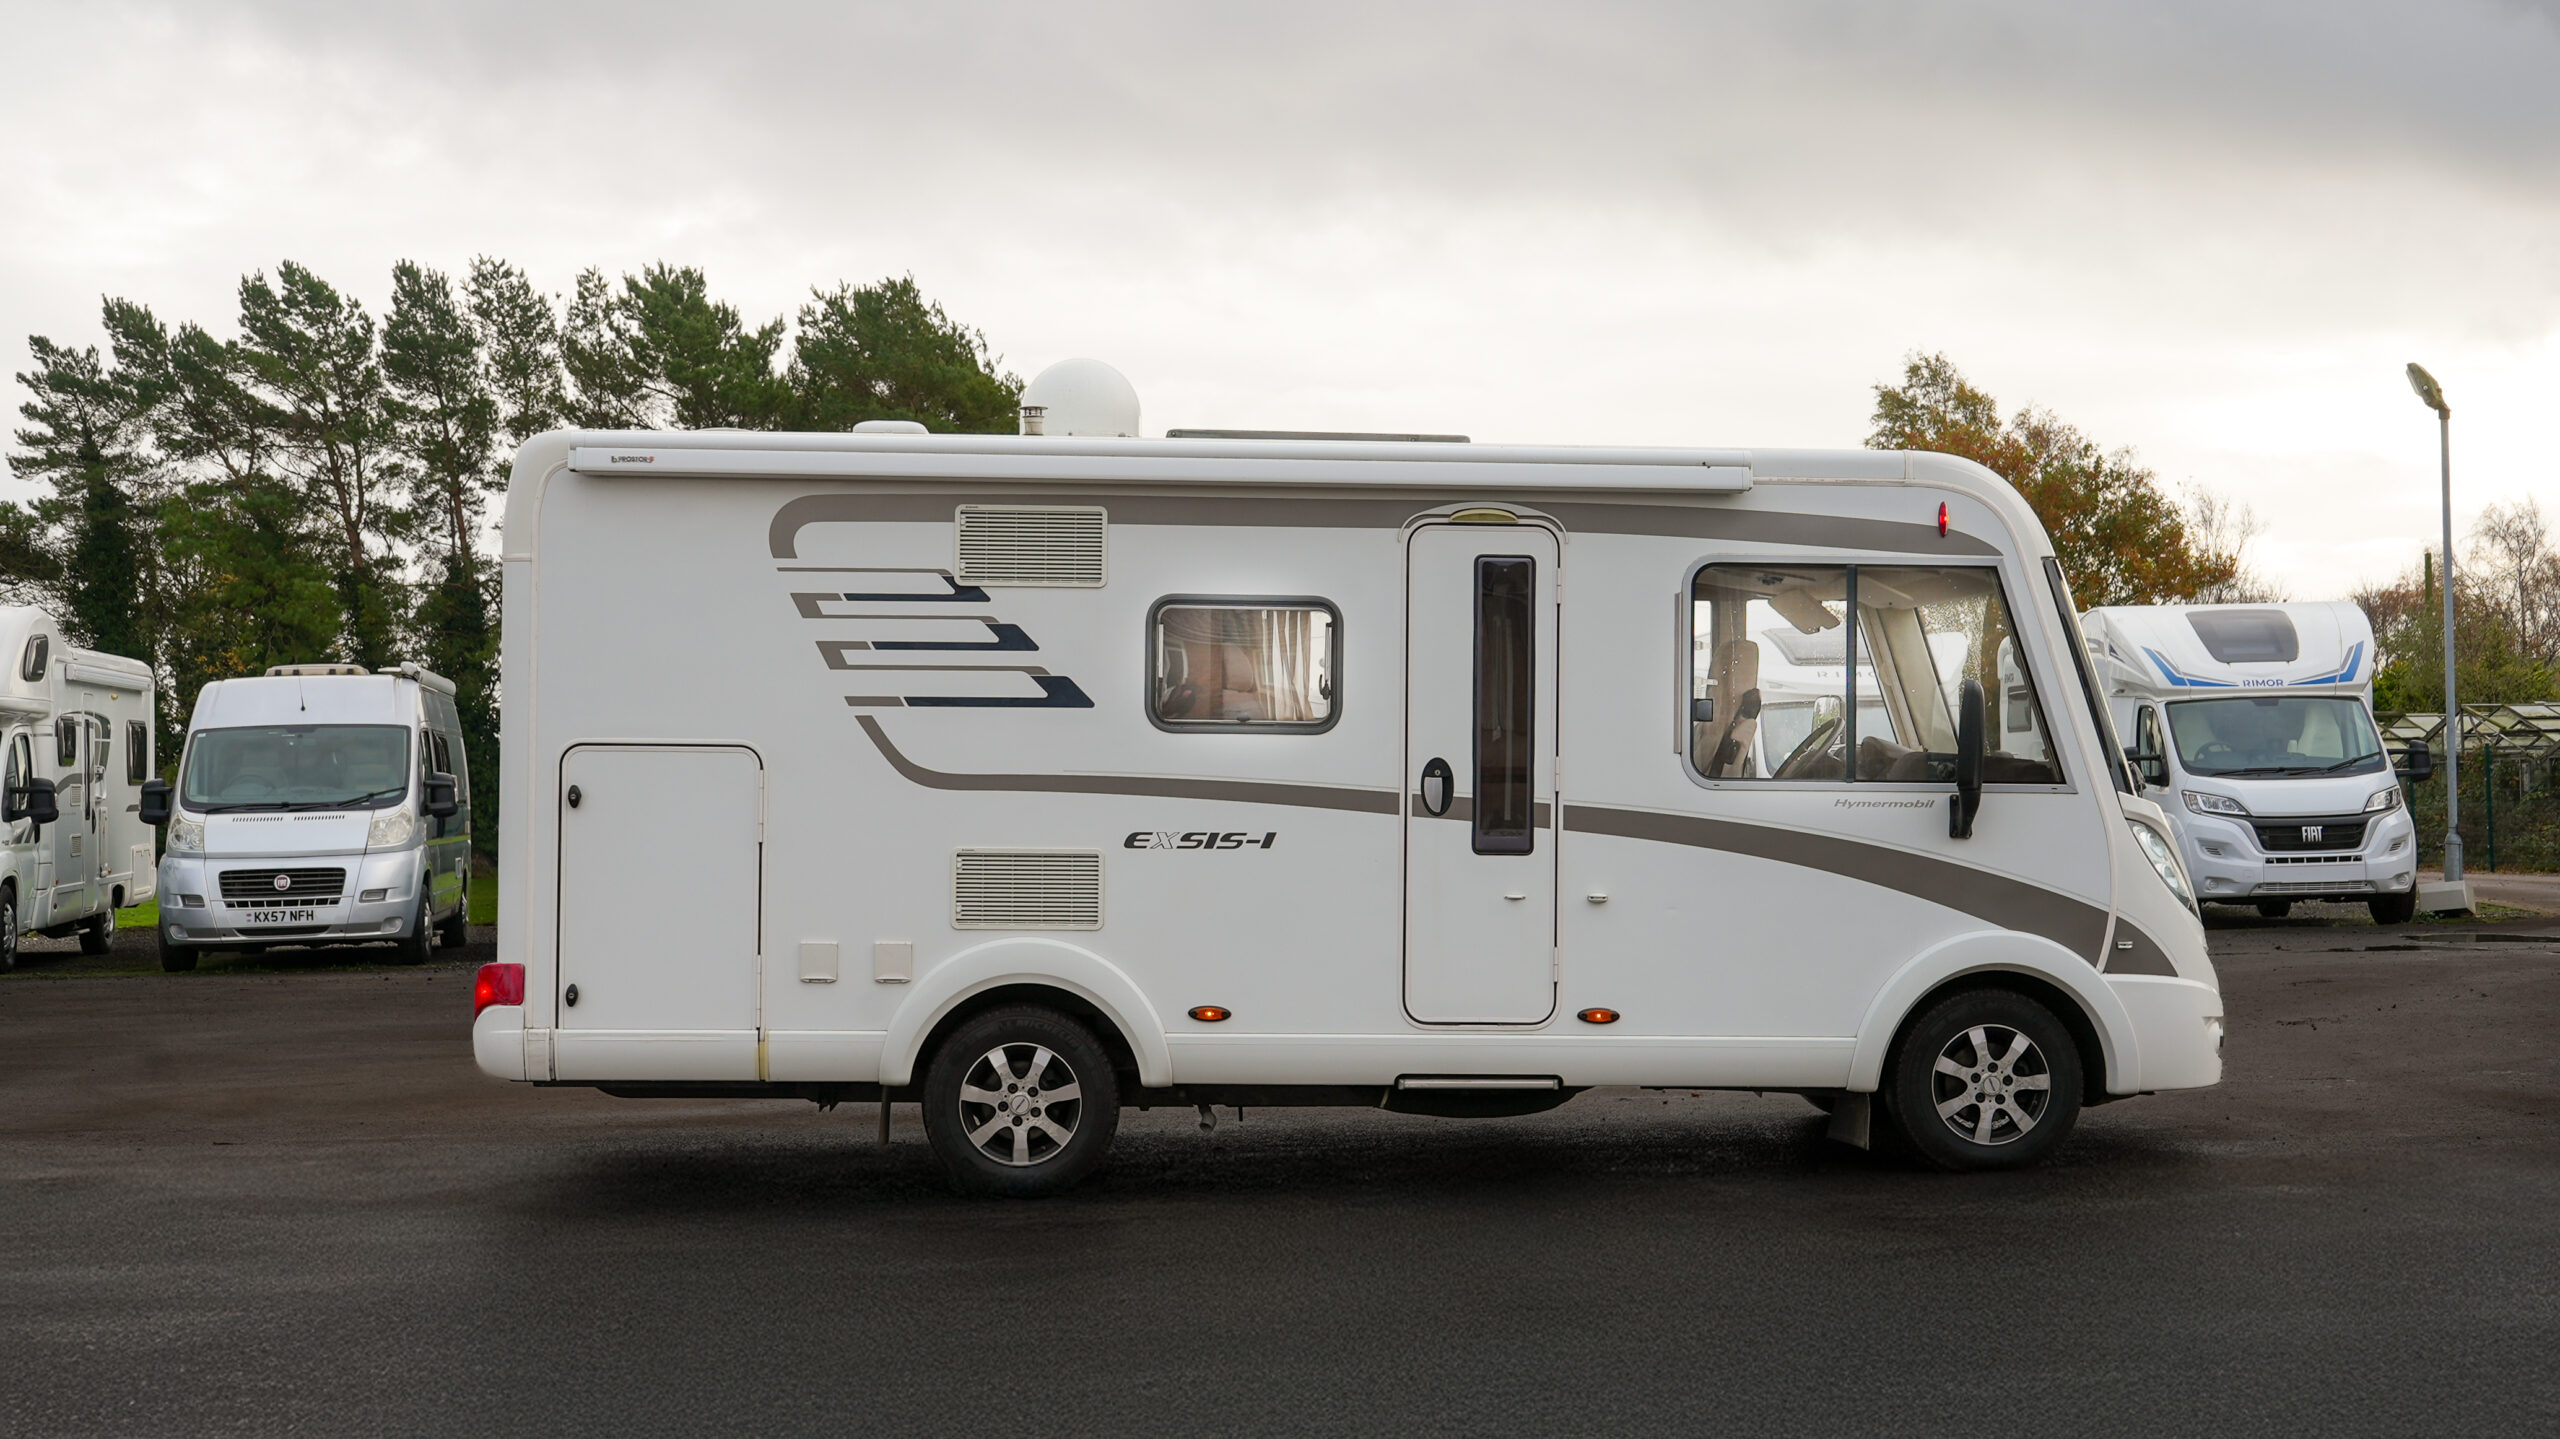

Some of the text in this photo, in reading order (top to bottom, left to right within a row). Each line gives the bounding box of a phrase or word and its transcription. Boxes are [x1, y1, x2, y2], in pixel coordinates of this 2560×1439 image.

[2243, 679, 2284, 687] RIMOR
[1834, 798, 1936, 809] Hymermobil
[1123, 831, 1278, 850] EXSIS-I
[2301, 825, 2323, 843] FIAT
[254, 909, 314, 923] KX57 NFH
